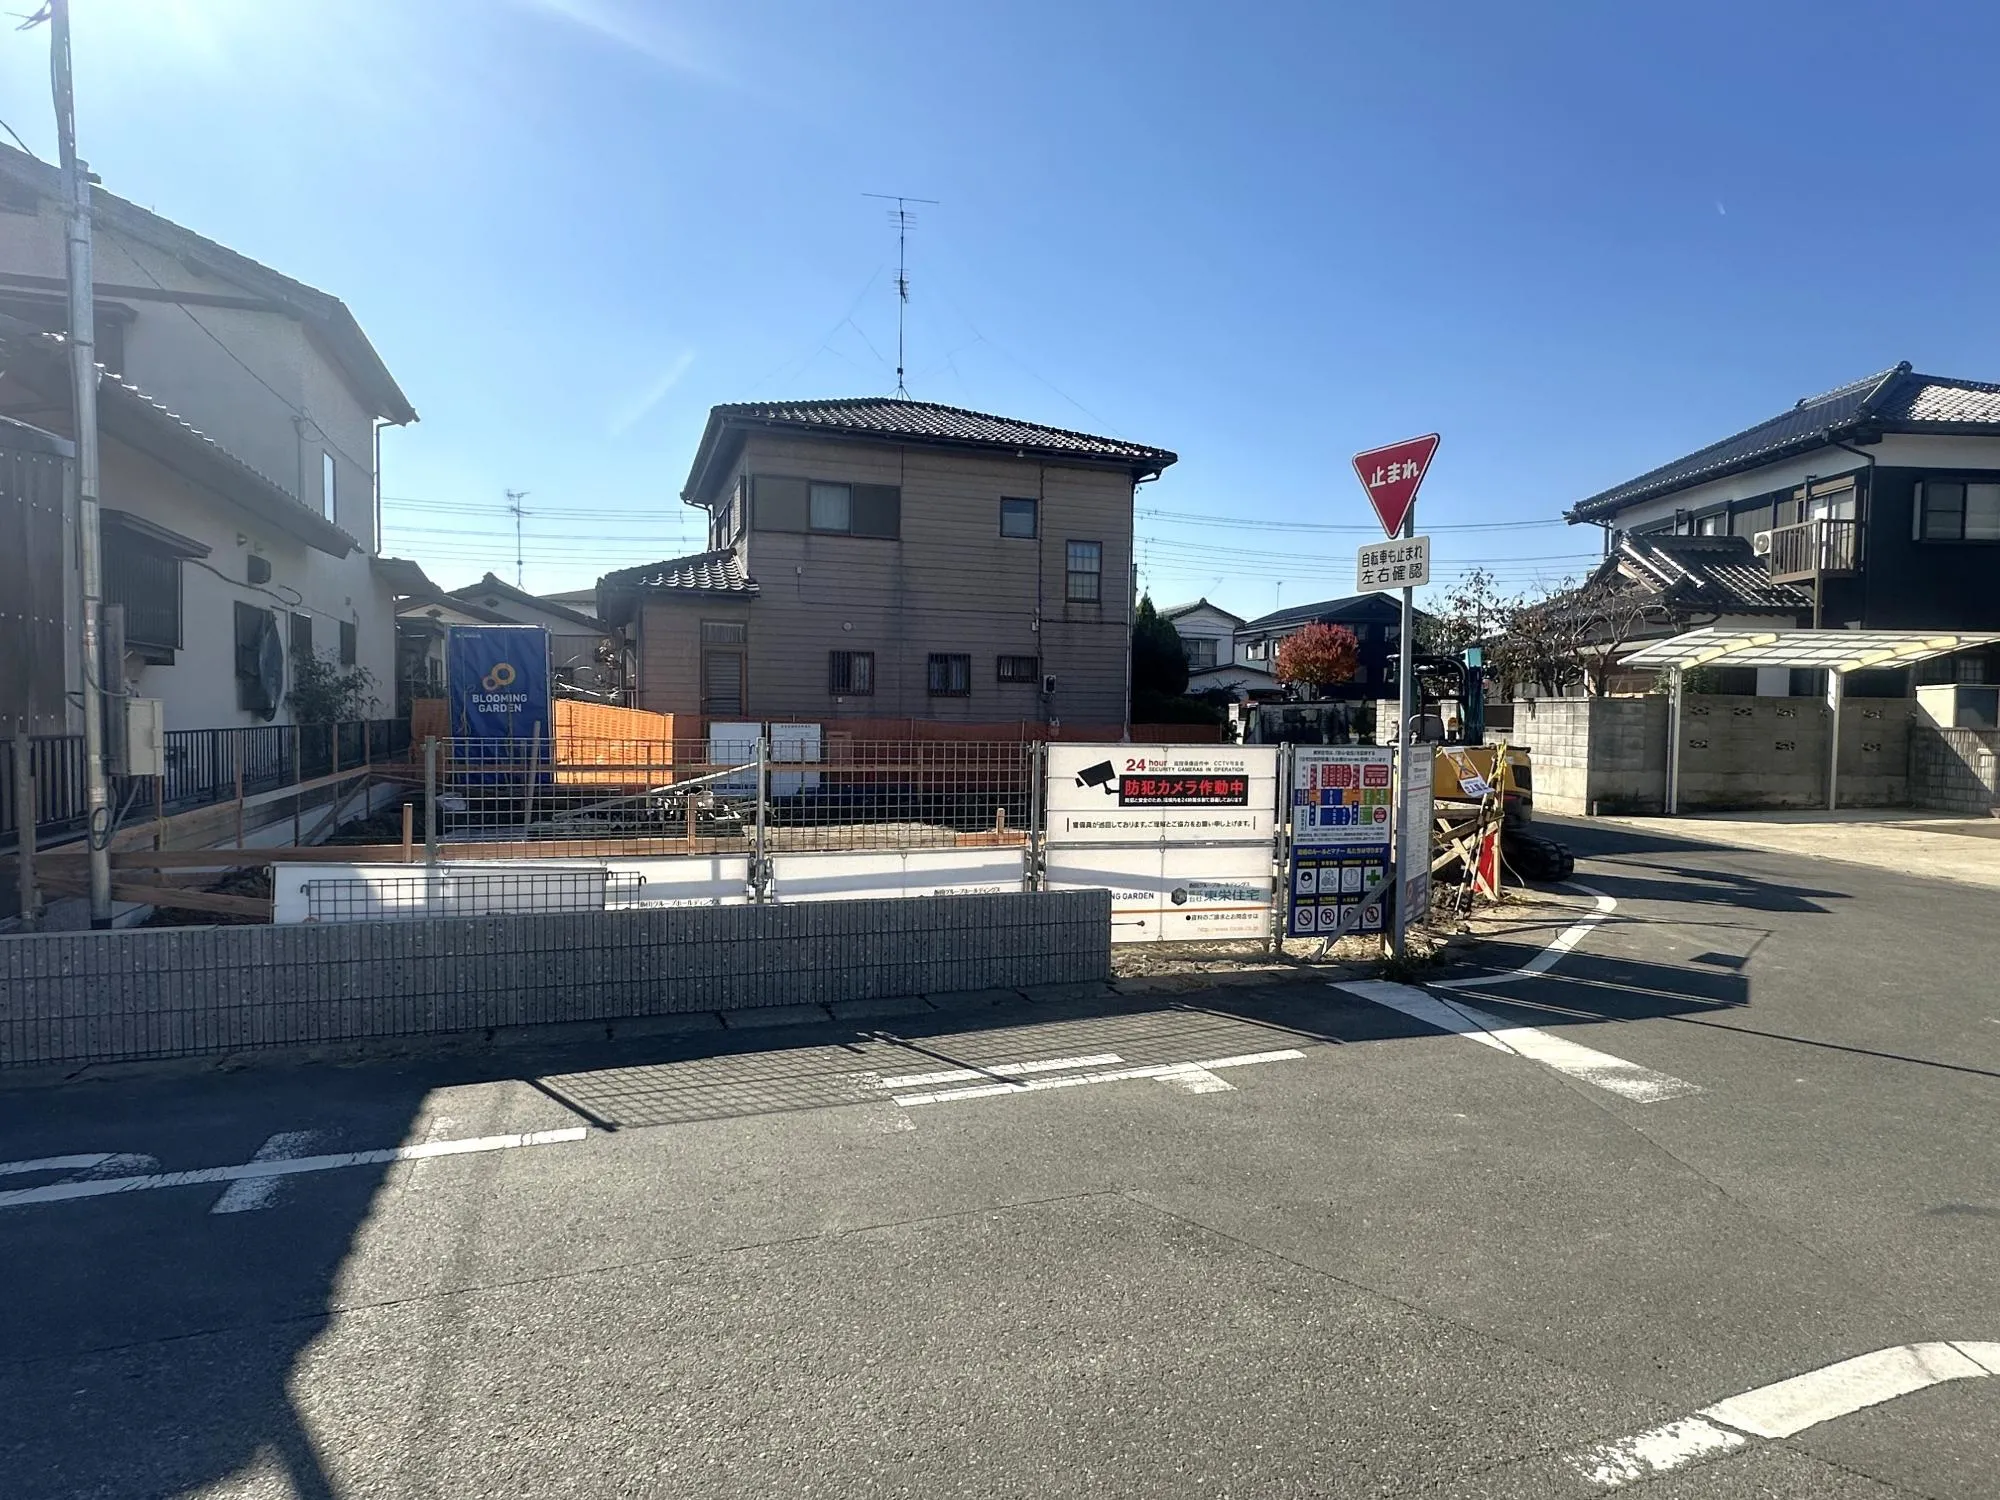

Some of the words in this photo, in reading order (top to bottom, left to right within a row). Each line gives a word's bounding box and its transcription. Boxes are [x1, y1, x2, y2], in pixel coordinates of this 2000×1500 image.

[1369, 458, 1420, 489] 止まれ
[1362, 545, 1423, 568] 自転車も止まれ
[1361, 562, 1423, 585] 左右確認
[472, 693, 528, 703] BLOOMING
[478, 703, 523, 713] GARDEN
[1126, 758, 1147, 772] 24
[1148, 759, 1168, 768] hour
[1126, 780, 1244, 796] 防犯カメラ作動中
[1123, 892, 1154, 900] GARDEN
[1204, 889, 1260, 901] 東栄住宅
